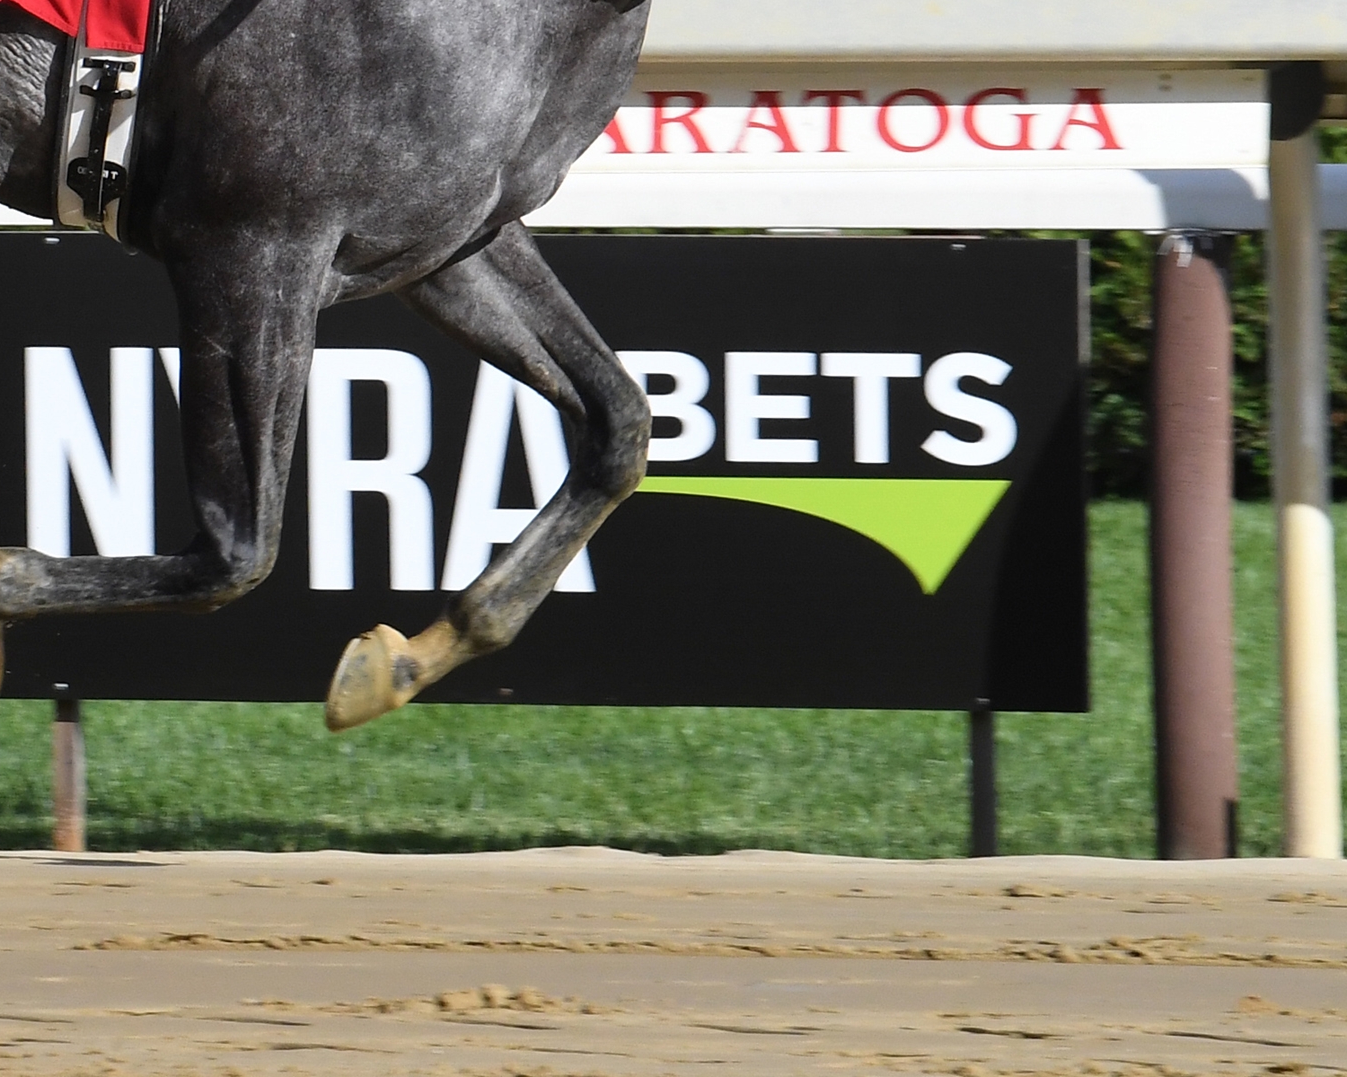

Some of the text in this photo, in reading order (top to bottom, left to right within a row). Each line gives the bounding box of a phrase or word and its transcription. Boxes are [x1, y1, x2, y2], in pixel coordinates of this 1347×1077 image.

[603, 87, 1124, 154] RATOGA
[24, 346, 1017, 592] NRA BETS
